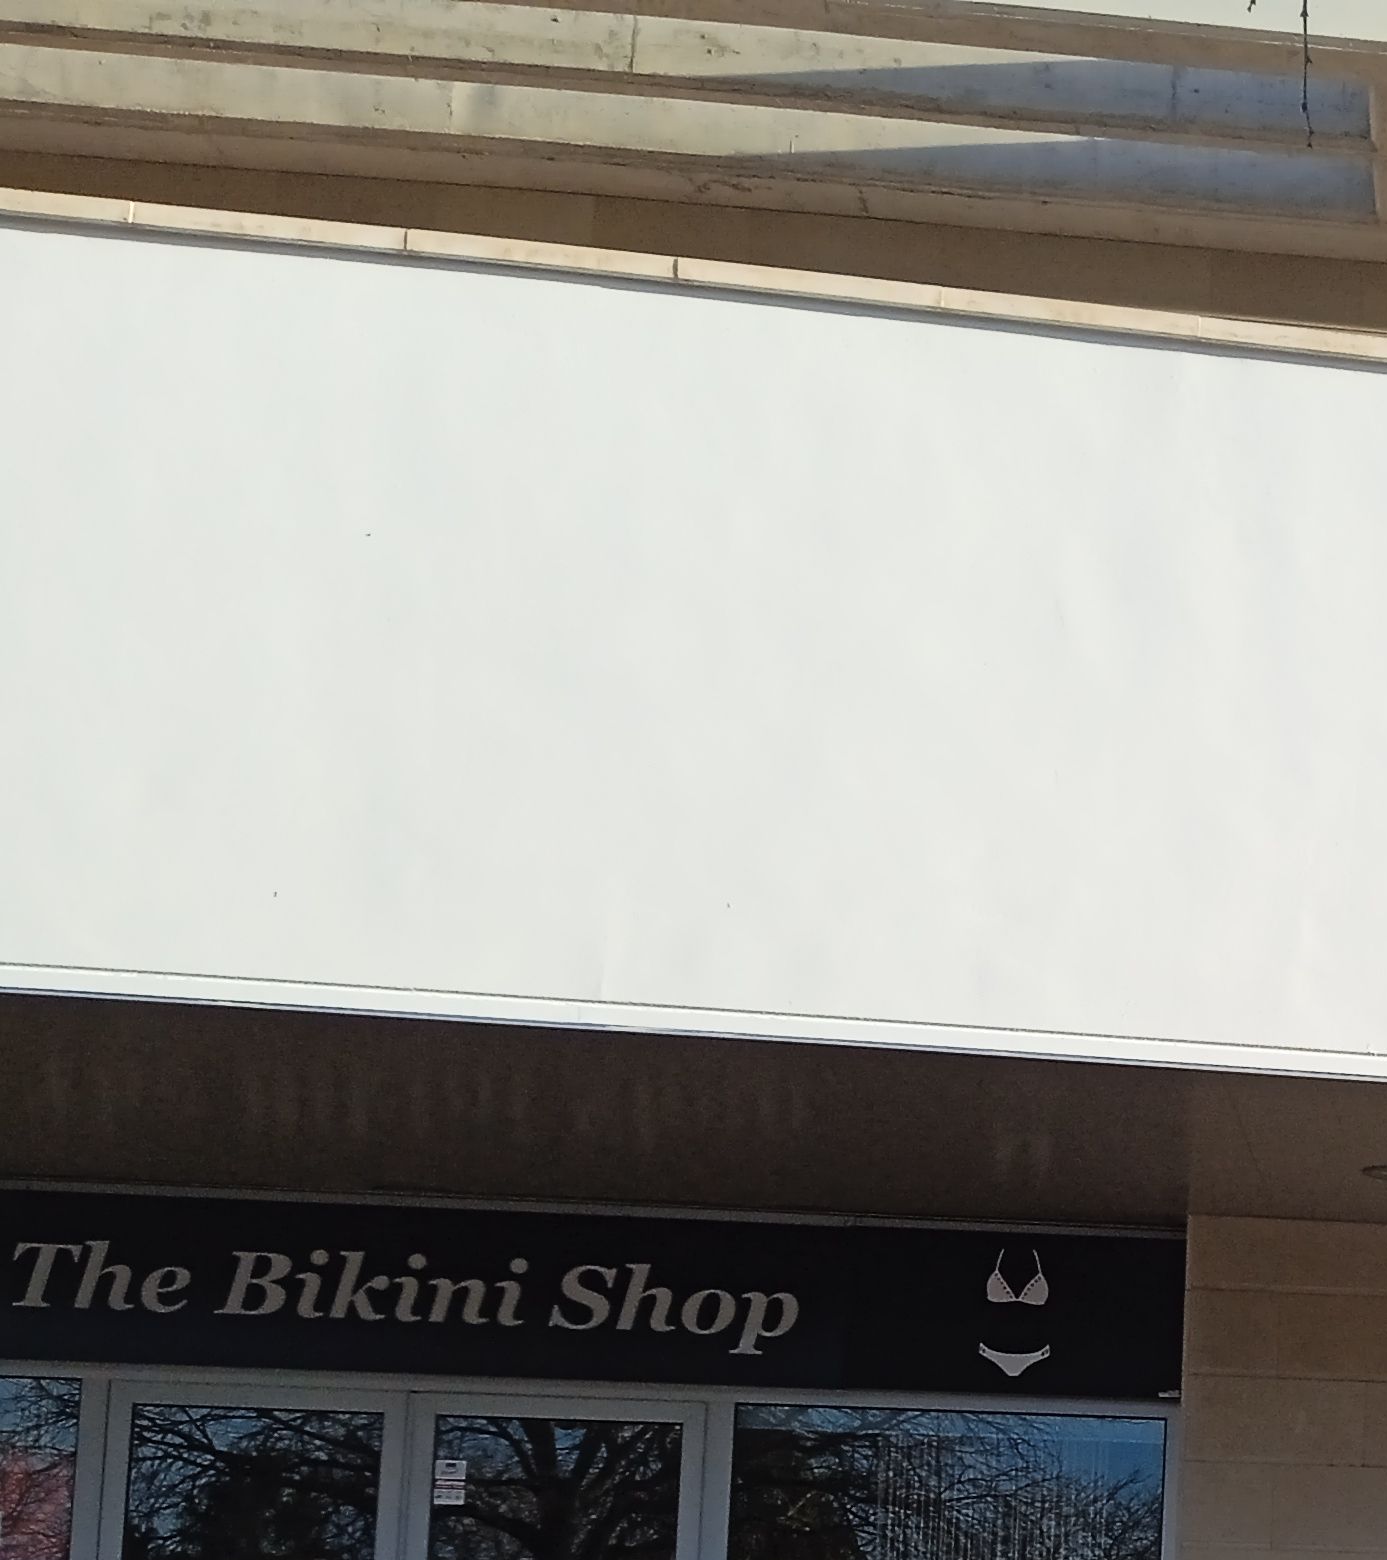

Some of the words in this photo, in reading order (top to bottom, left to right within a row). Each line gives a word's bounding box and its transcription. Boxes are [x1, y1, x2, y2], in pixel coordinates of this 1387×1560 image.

[12, 1240, 191, 1312] The
[213, 1249, 527, 1326] Bikini
[548, 1263, 799, 1355] Shop
